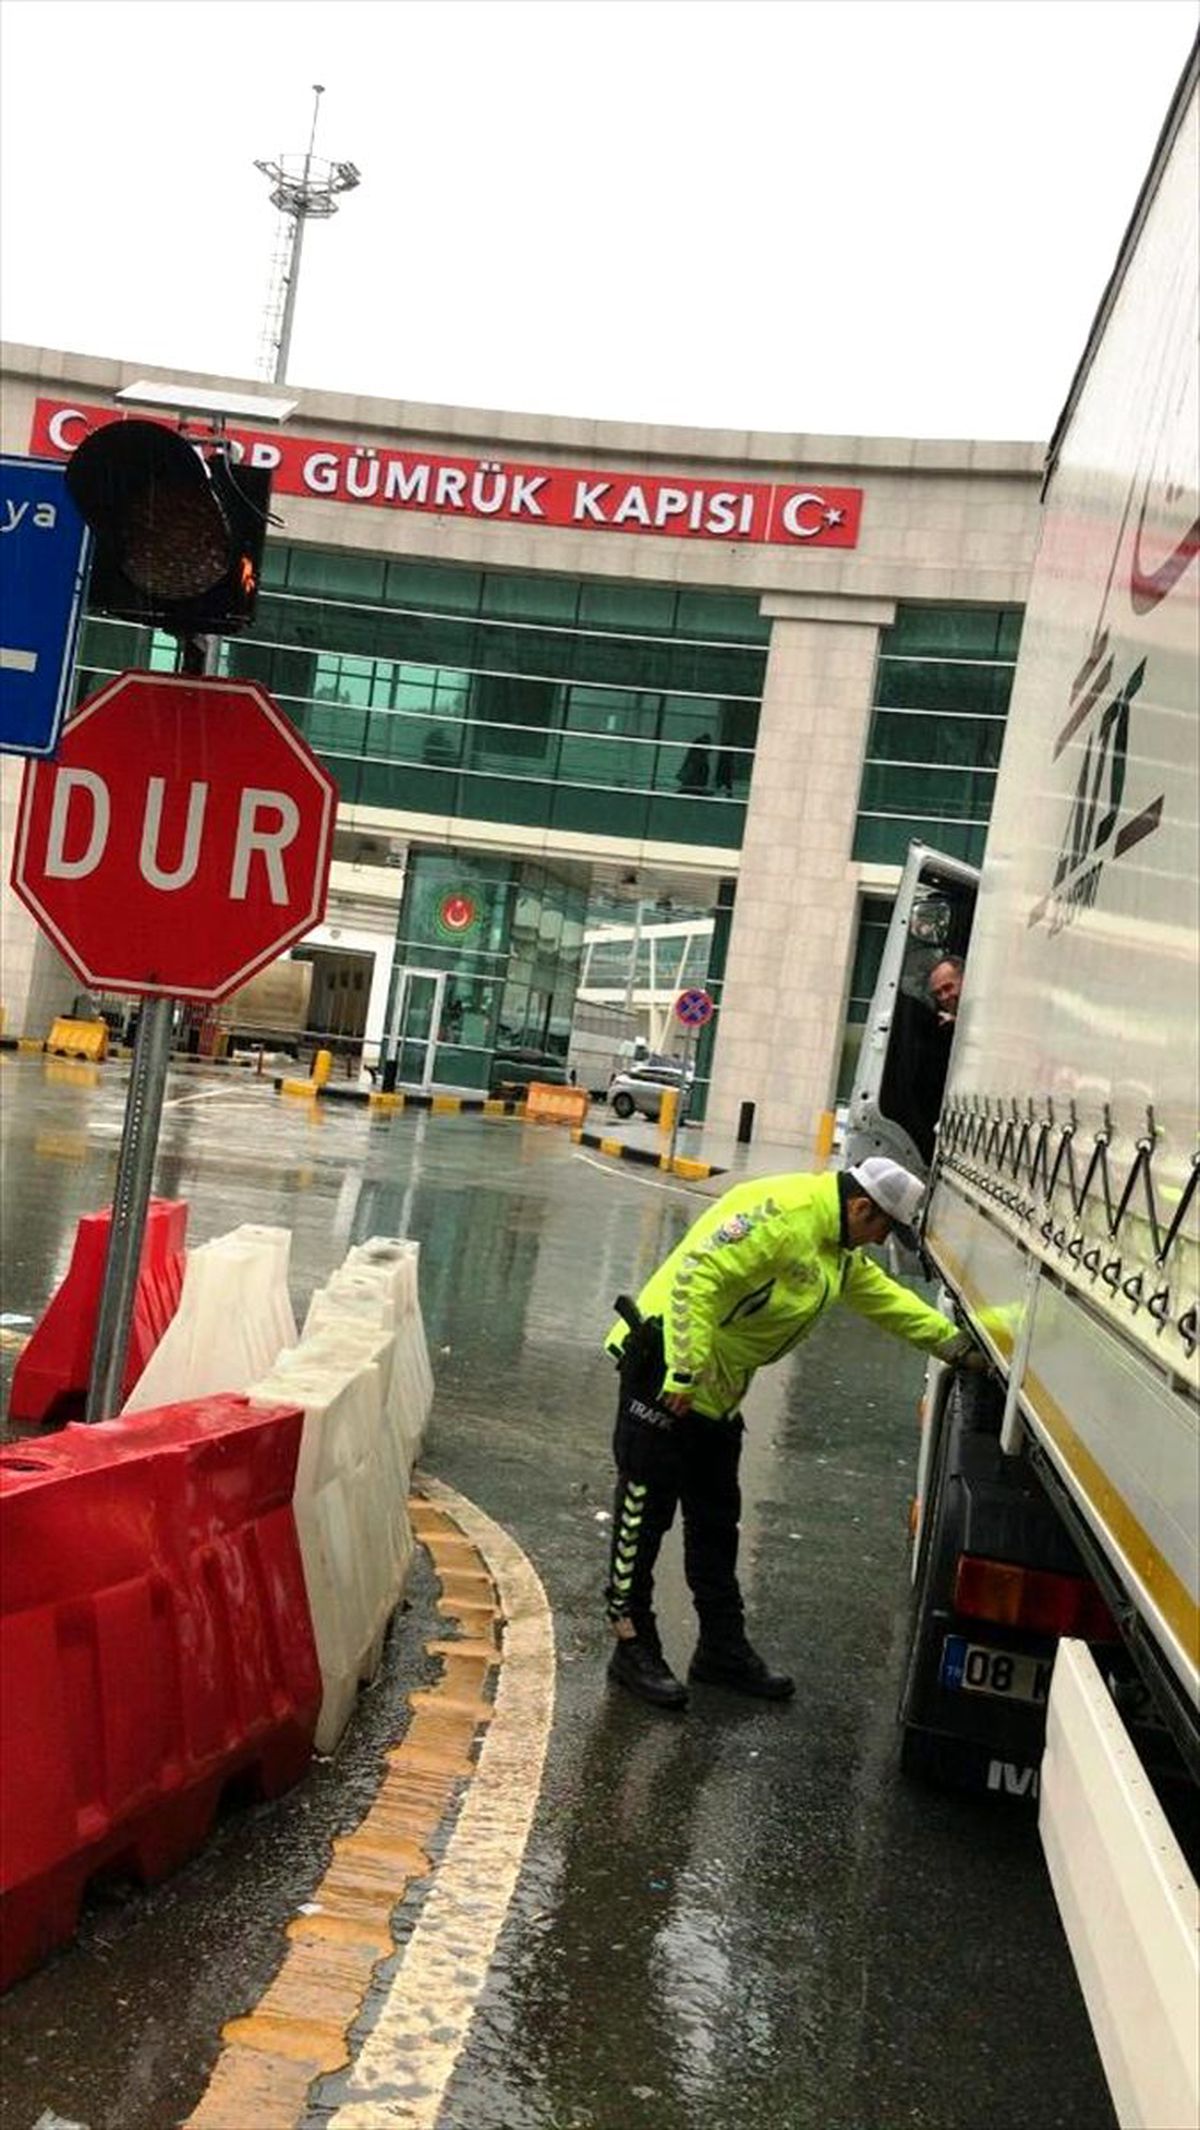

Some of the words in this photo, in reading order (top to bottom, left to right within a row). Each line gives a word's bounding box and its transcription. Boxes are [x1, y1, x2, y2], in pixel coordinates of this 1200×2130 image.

[303, 448, 548, 516] GÜMRÜK
[573, 482, 754, 535] KAPISI
[45, 766, 299, 906] DUR
[967, 1651, 1014, 1690] 08
[987, 1760, 1038, 1799] IV
